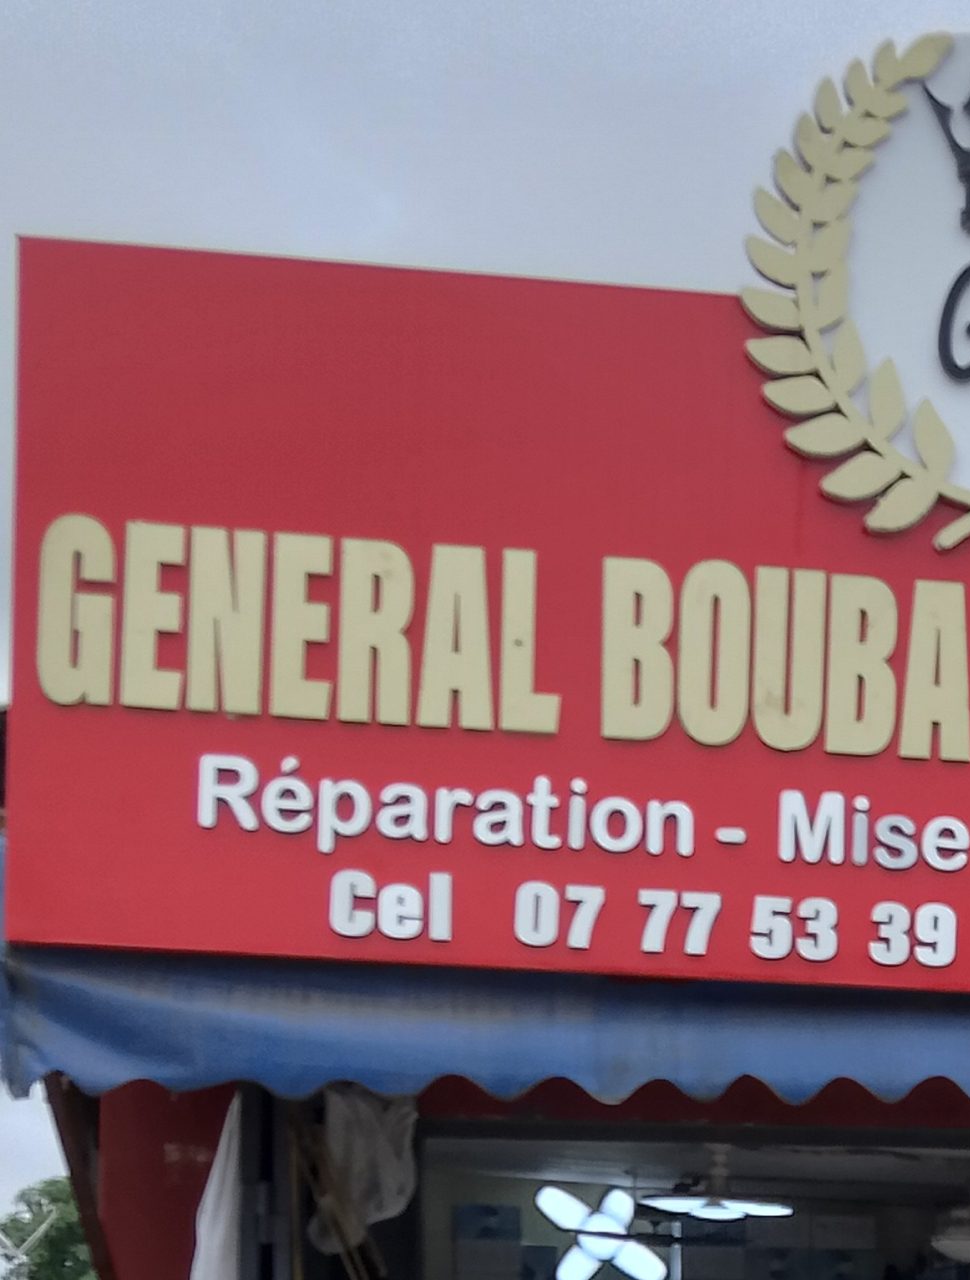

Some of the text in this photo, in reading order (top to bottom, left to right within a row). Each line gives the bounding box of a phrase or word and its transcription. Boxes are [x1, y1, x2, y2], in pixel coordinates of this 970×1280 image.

[36, 513, 563, 735] GENERAL
[196, 753, 696, 859] Réparation
[715, 826, 748, 845] -
[328, 868, 453, 942] Cel
[513, 880, 606, 949] 07
[637, 888, 722, 955] 77
[749, 894, 838, 961] 53
[868, 900, 957, 967] 39
